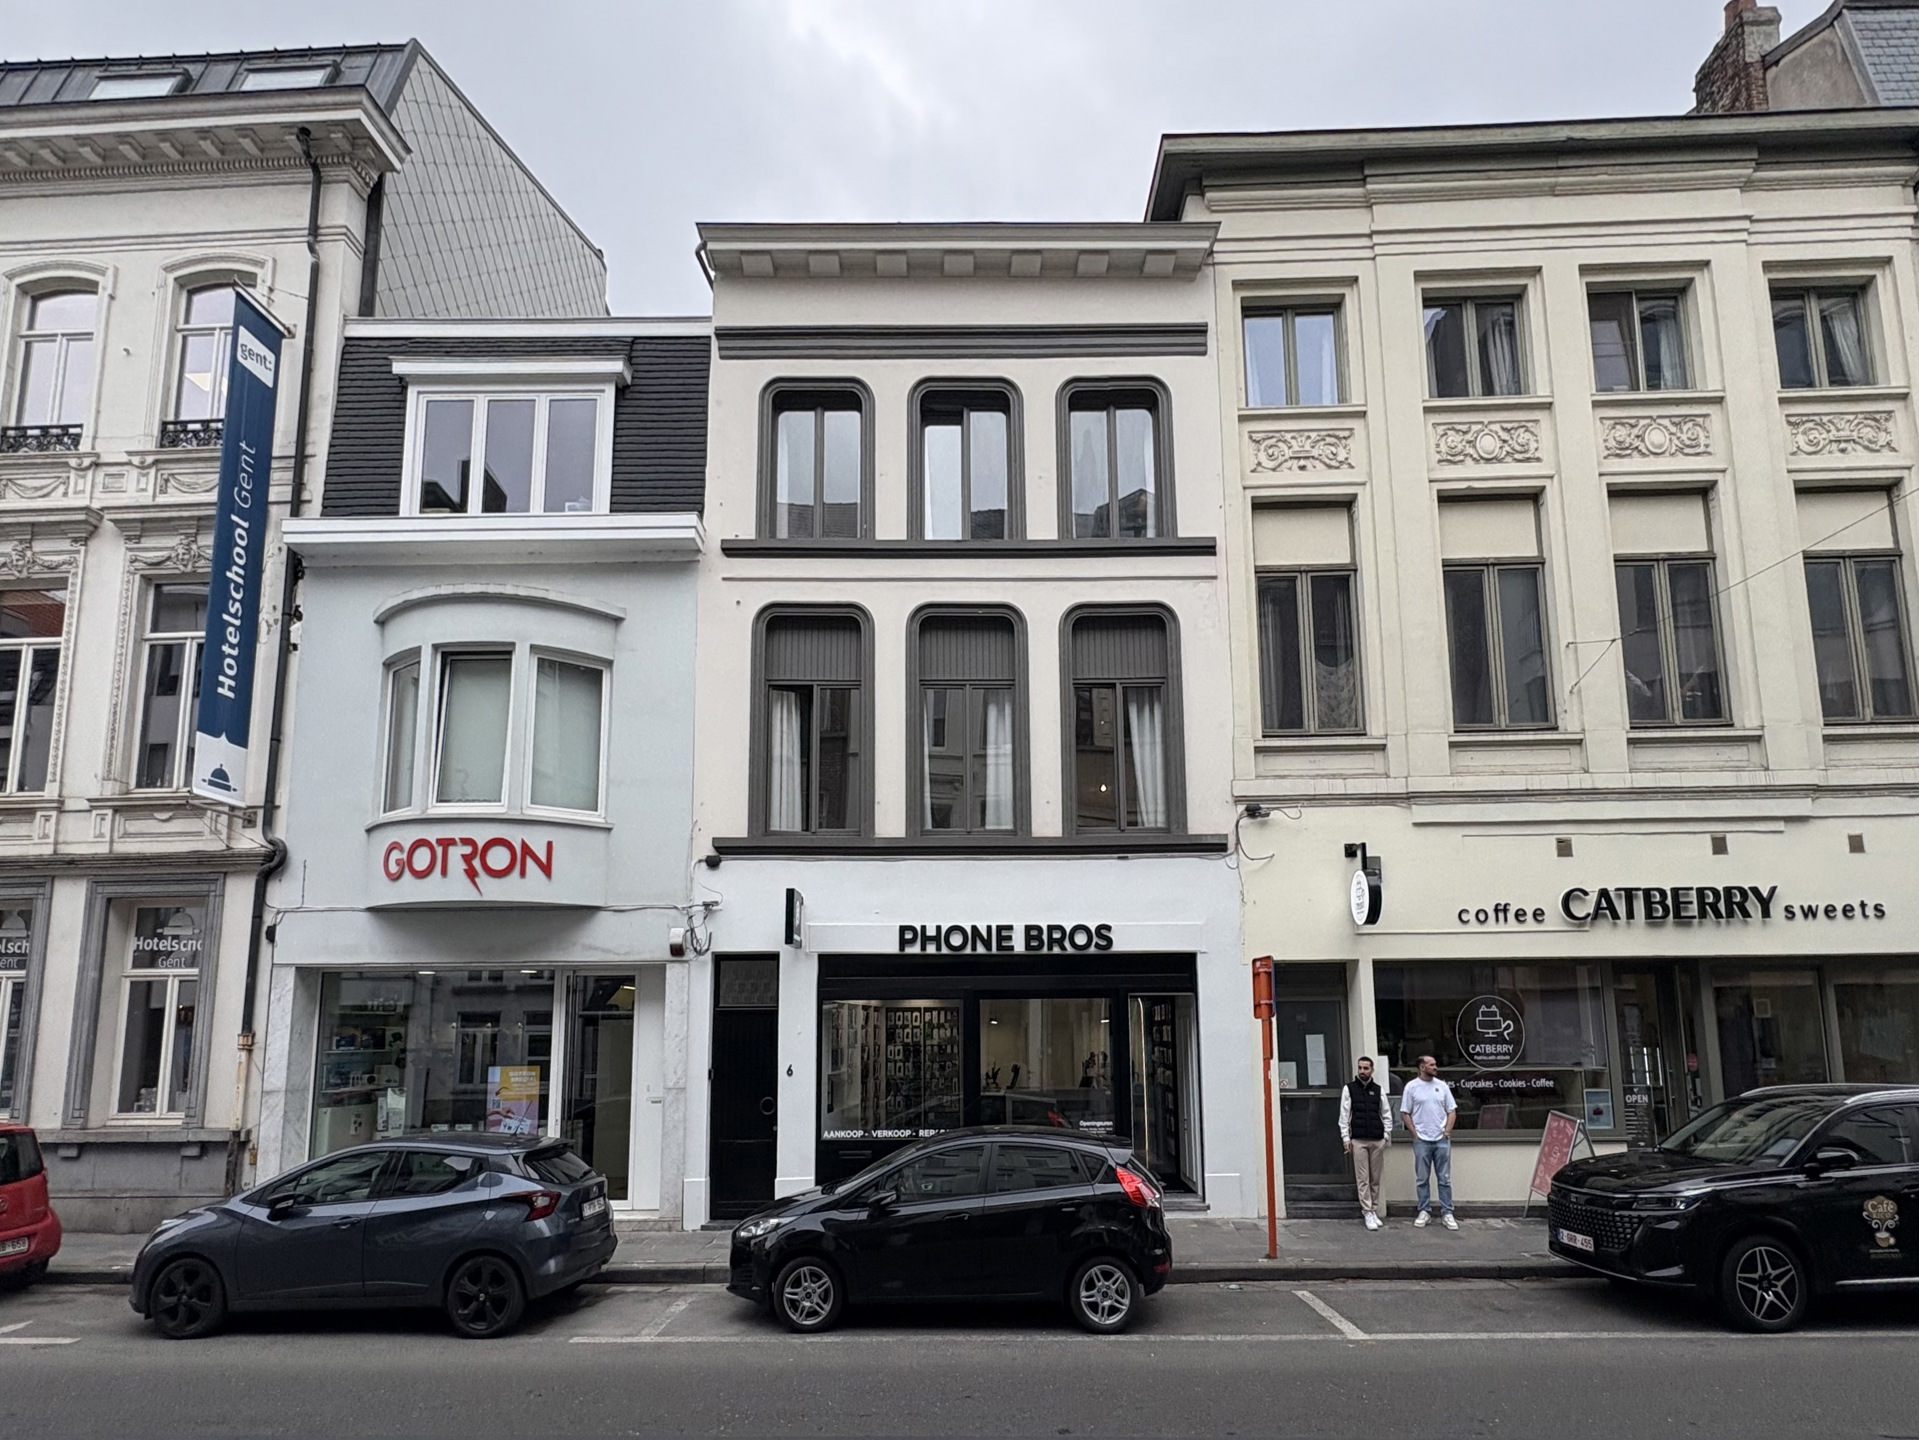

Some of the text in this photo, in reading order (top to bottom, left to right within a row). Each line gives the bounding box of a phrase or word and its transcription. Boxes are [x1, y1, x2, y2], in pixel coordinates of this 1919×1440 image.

[217, 439, 257, 699] Hotelschool Gent
[383, 836, 554, 897] GOTRON
[1457, 885, 1887, 925] coffee CATBERRY sweets
[898, 923, 1114, 952] PHONE BROS
[158, 956, 186, 968] Gent
[1469, 1044, 1514, 1053] CATBERRY
[786, 1064, 794, 1077] 6
[1460, 1079, 1494, 1090] Cupcakes
[1499, 1078, 1526, 1088] Cookies
[1531, 1078, 1555, 1088] Coffee
[1625, 1094, 1649, 1103] OPEN
[823, 1130, 864, 1138] AANKOOP
[871, 1129, 911, 1138] VERKOOP
